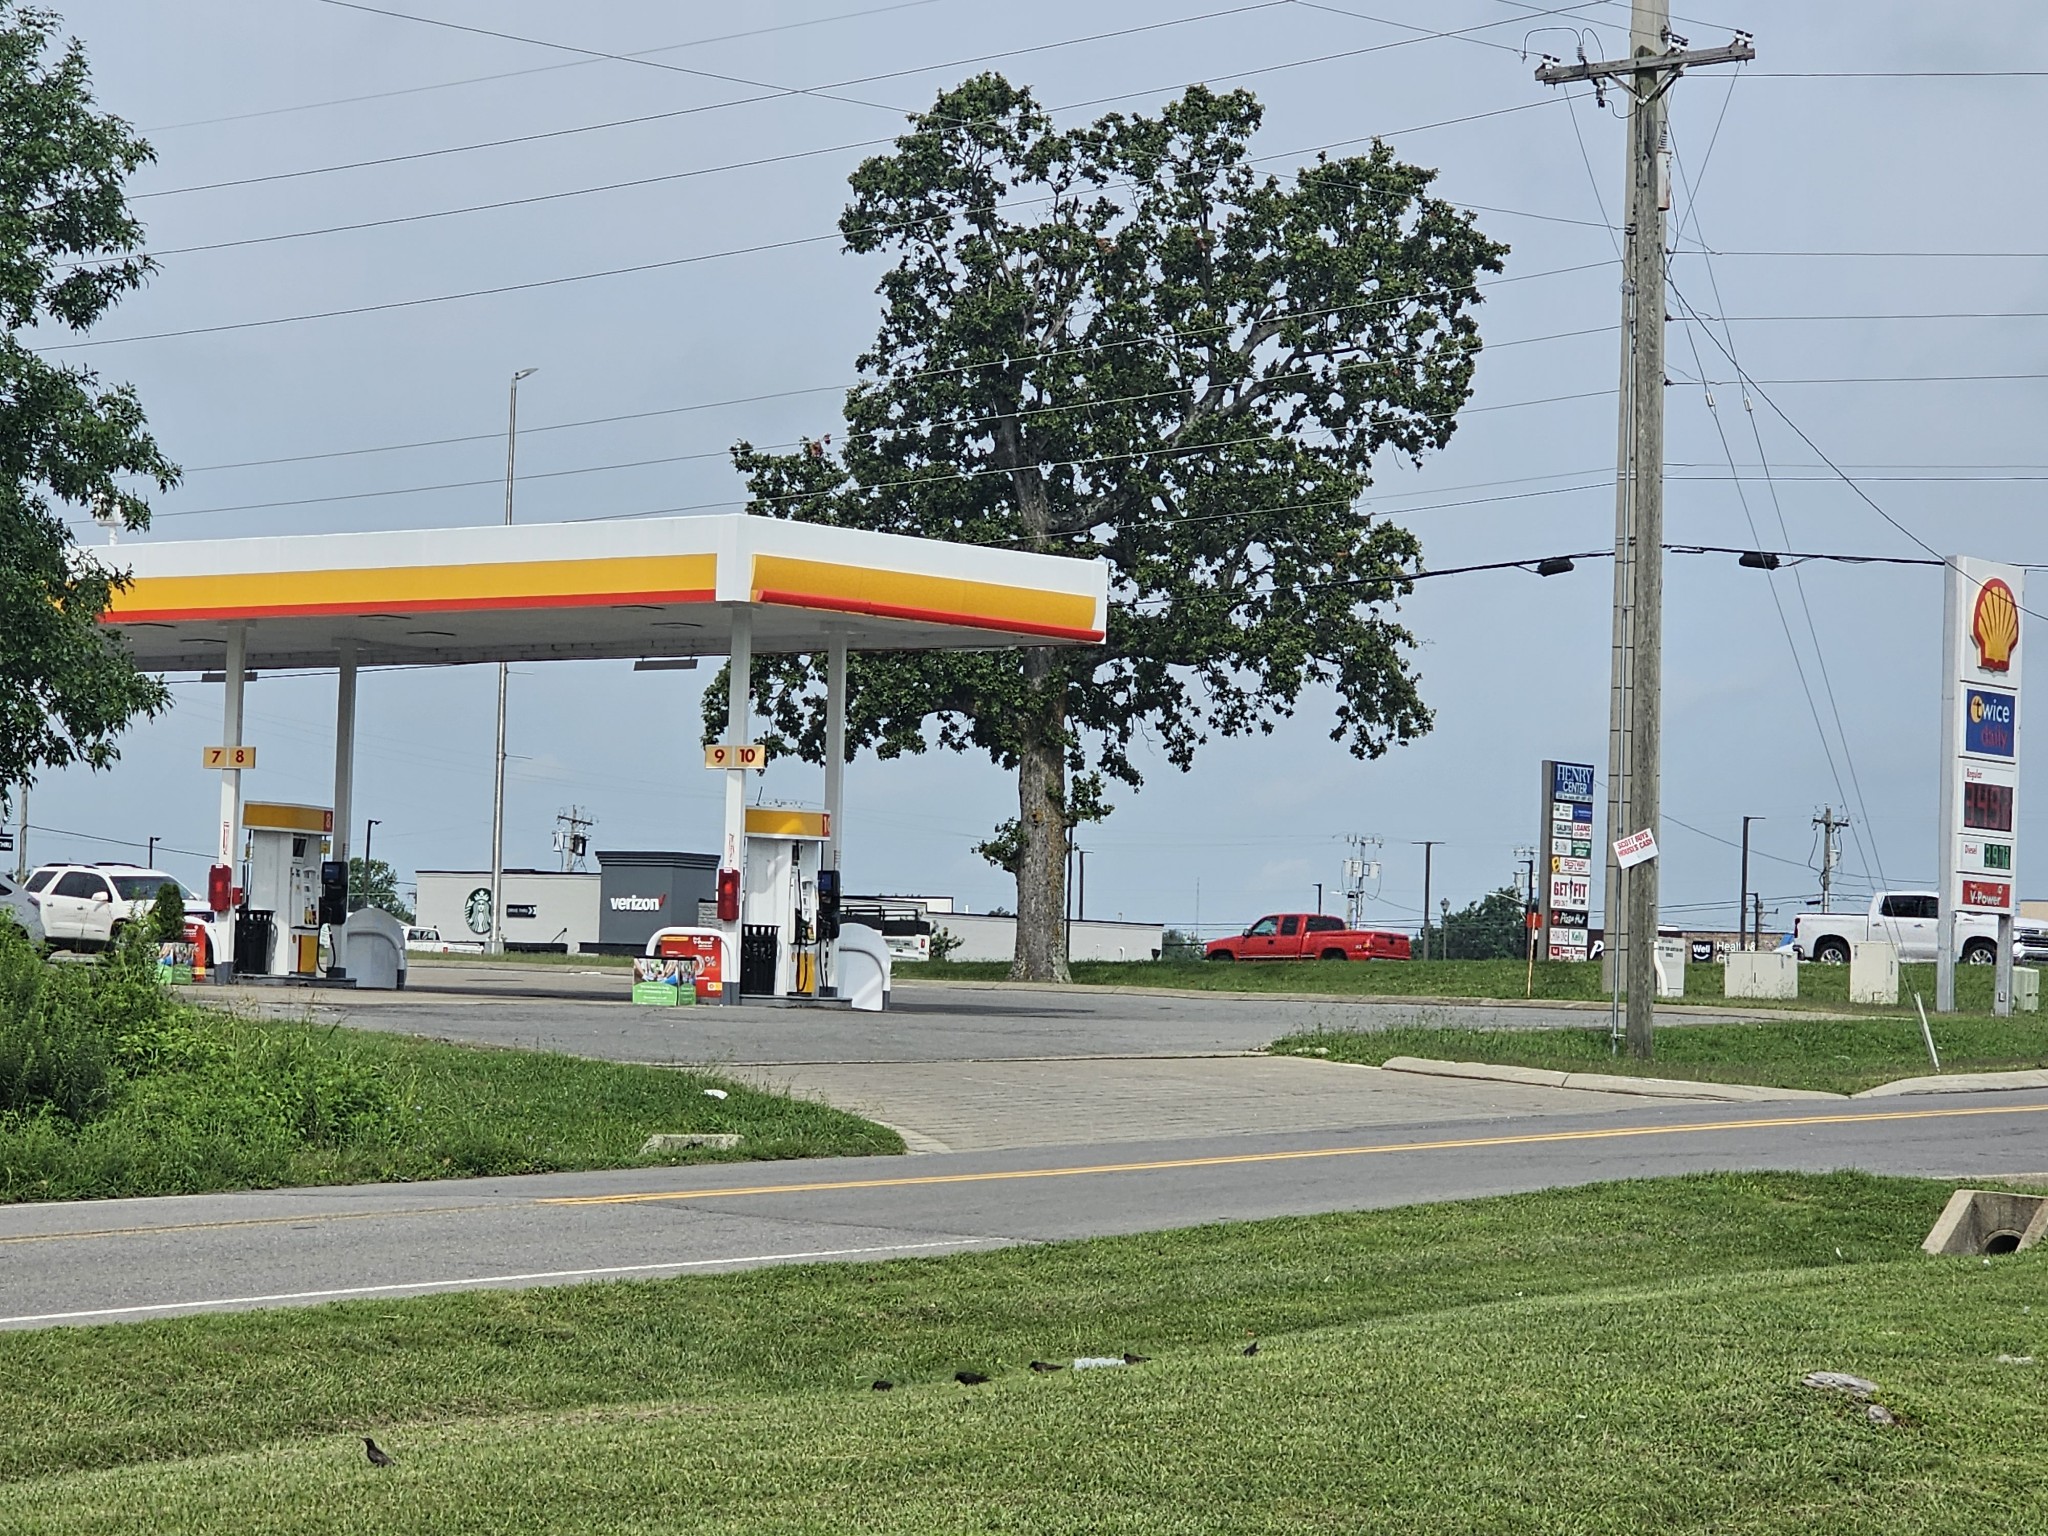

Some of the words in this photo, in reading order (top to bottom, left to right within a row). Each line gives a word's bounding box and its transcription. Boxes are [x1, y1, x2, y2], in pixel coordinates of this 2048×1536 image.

[1973, 698, 2010, 723] twice
[212, 751, 221, 763] 7
[235, 750, 244, 763] 8
[714, 749, 725, 763] 9
[740, 749, 756, 763] 10
[1557, 764, 1593, 784] HENRY
[1563, 780, 1588, 794] CENTER
[1553, 881, 1569, 896] GET
[1573, 883, 1587, 898] FIT
[1970, 889, 2002, 906] V-Power
[610, 894, 660, 911] verizon
[1692, 944, 1711, 954] Well
